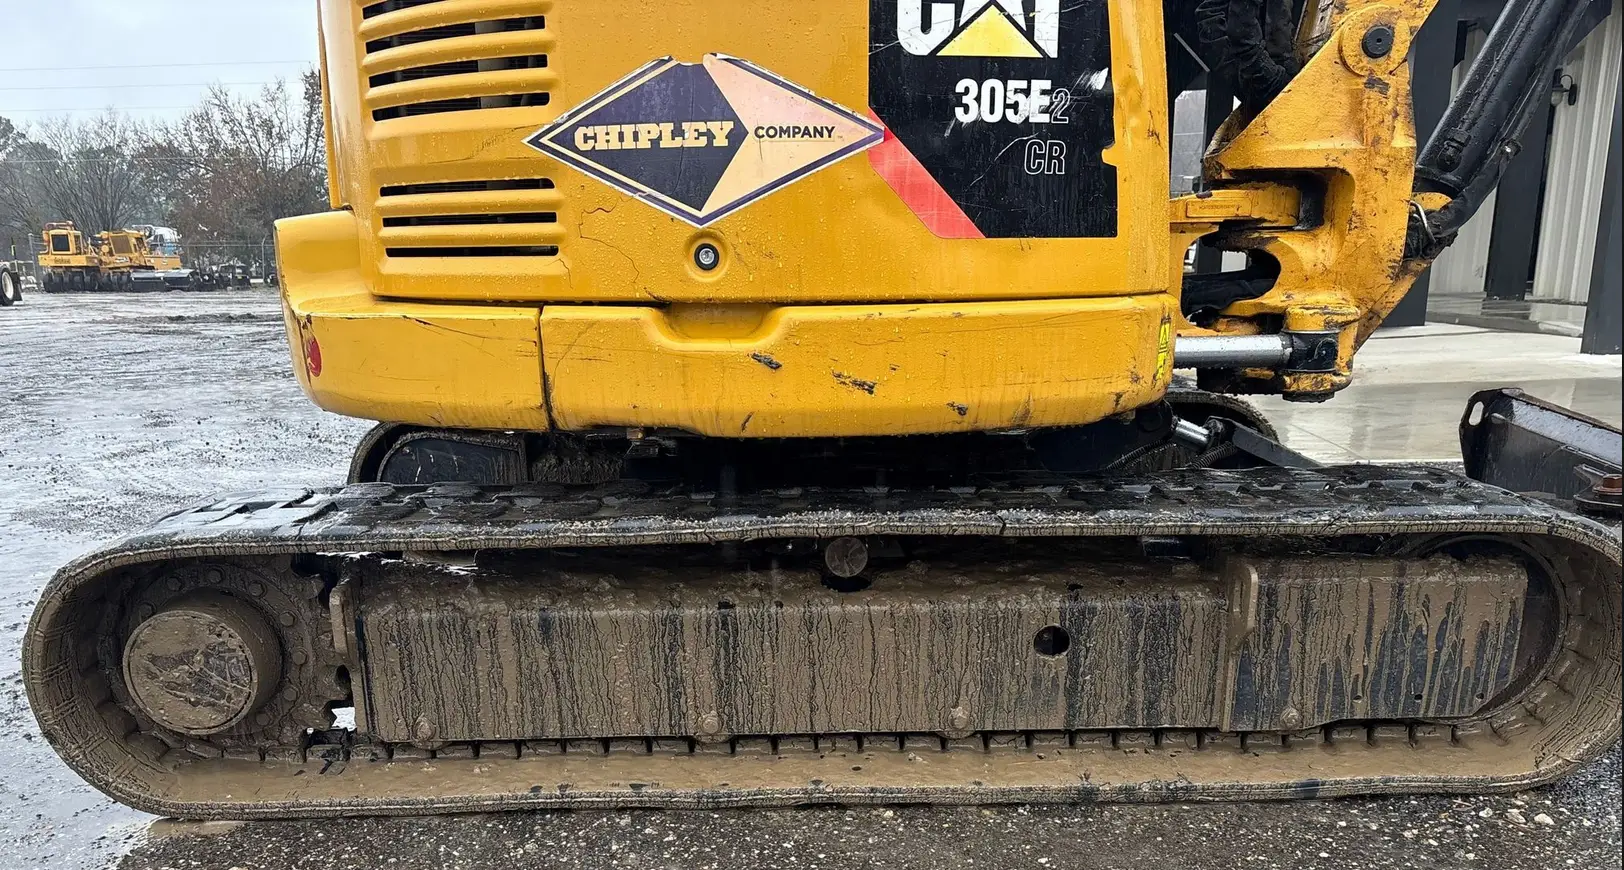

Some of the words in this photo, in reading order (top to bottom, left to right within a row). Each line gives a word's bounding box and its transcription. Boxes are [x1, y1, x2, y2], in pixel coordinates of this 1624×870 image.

[574, 121, 734, 151] CHIPLEY
[754, 125, 835, 139] COMPANY
[1024, 139, 1066, 175] CR
